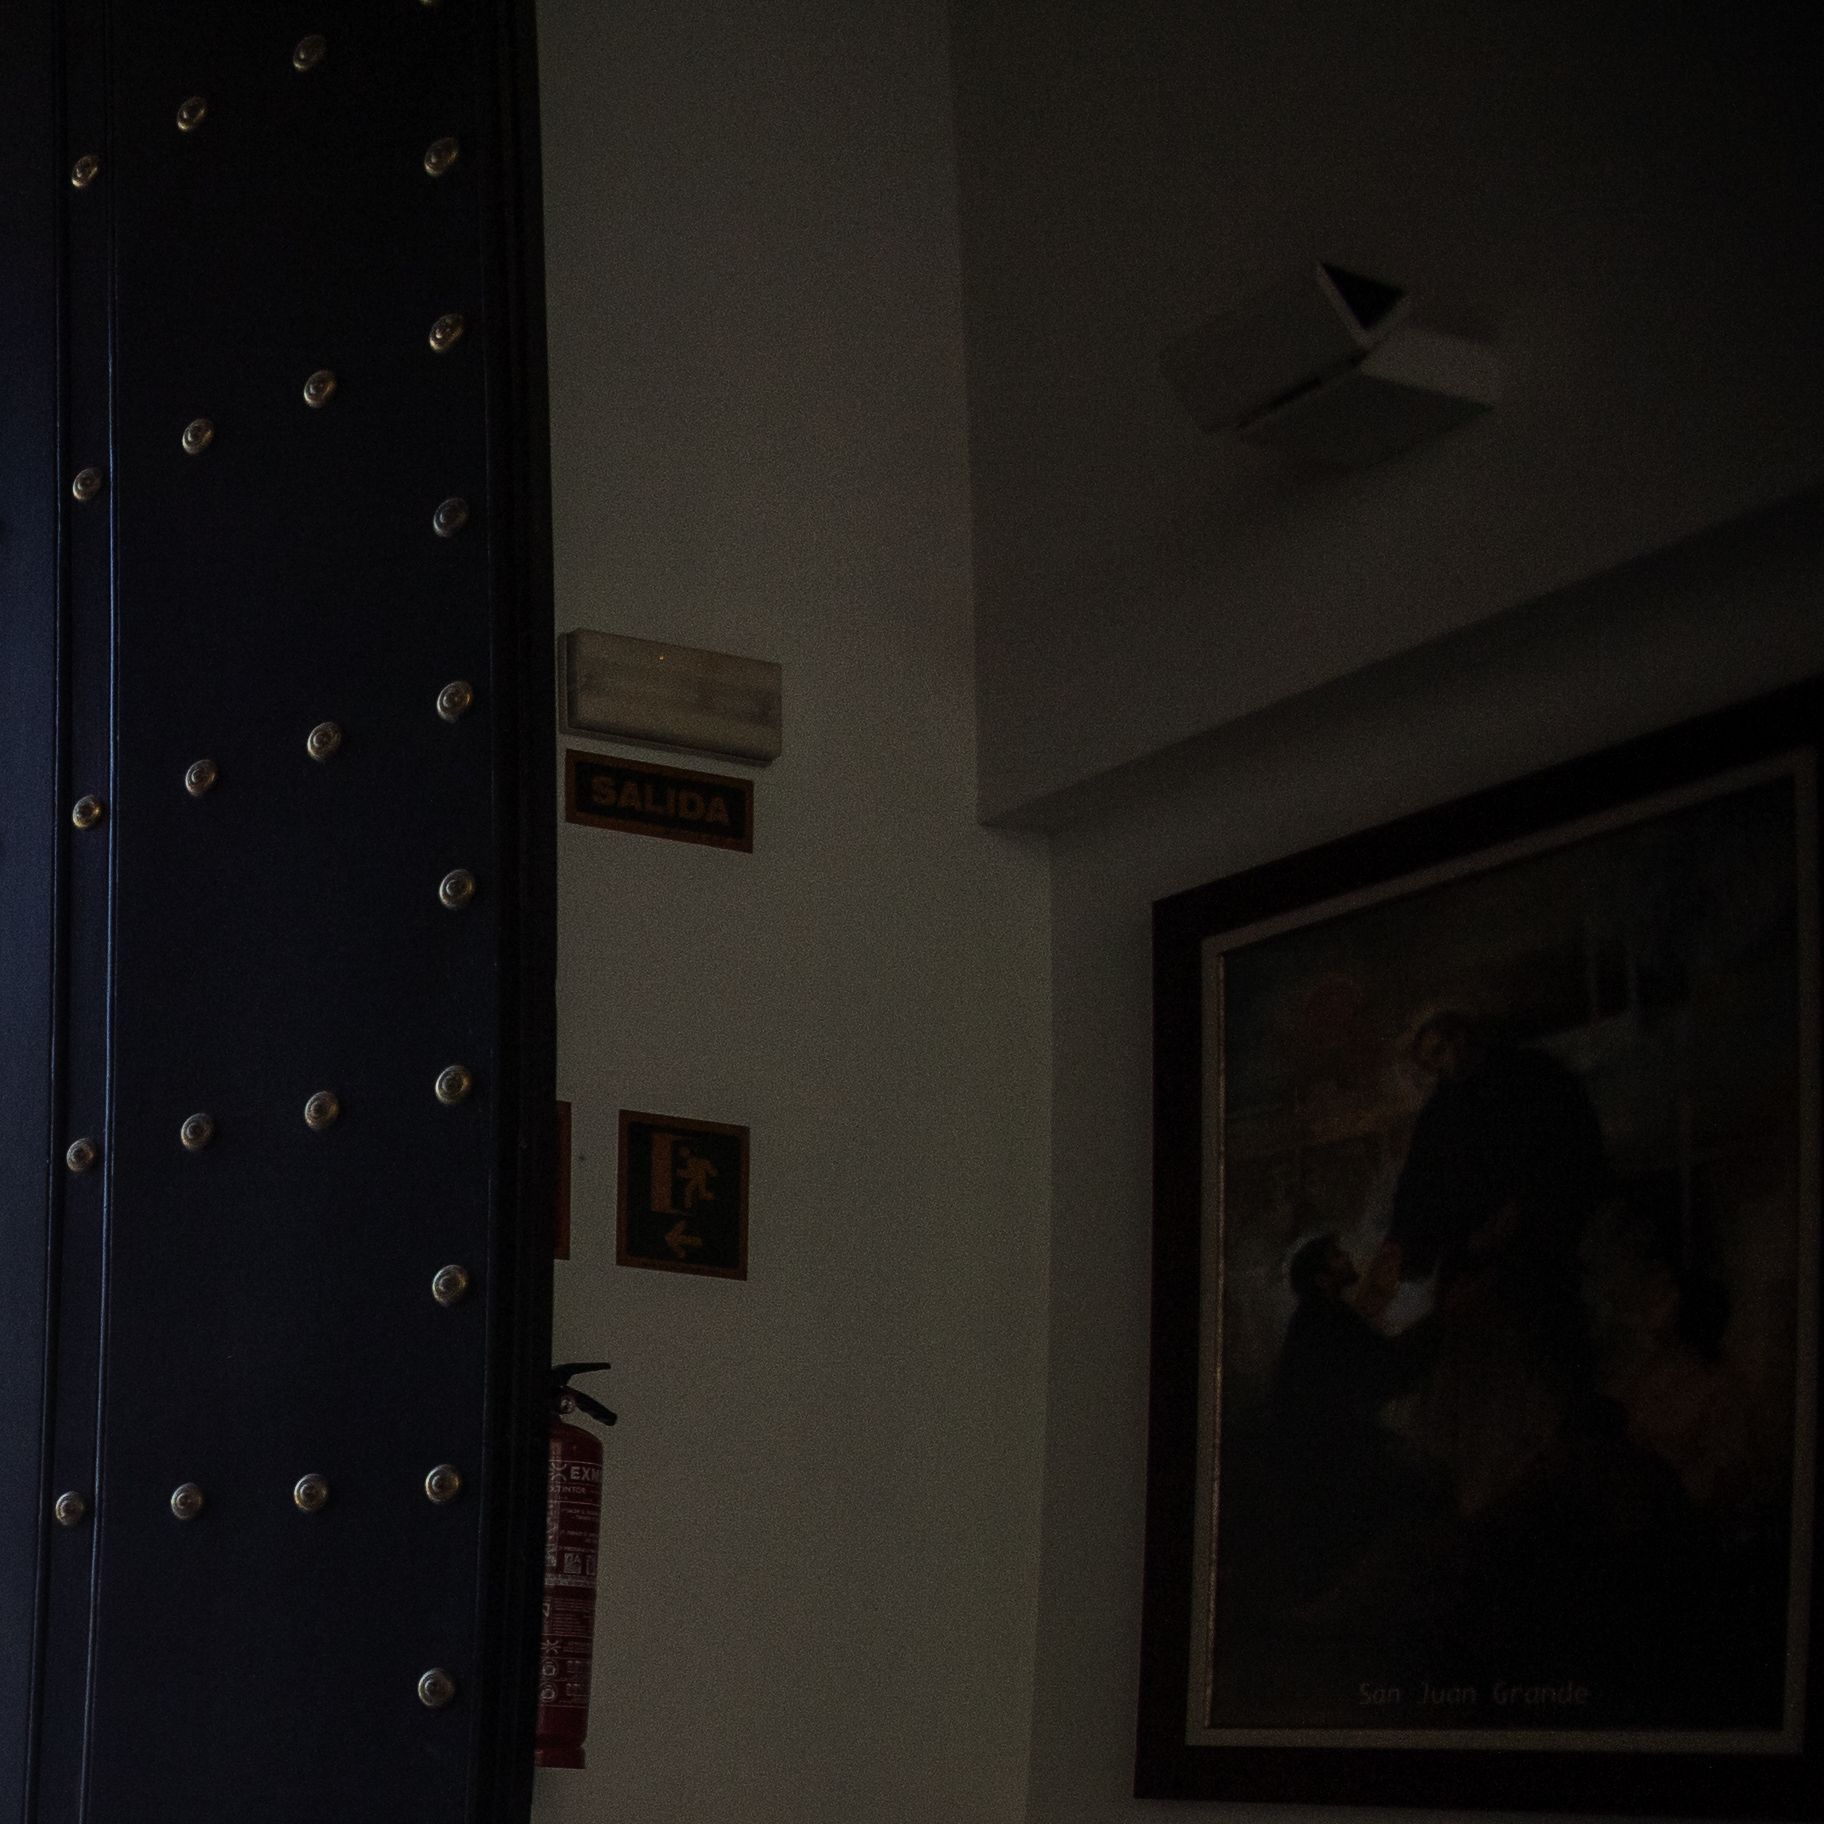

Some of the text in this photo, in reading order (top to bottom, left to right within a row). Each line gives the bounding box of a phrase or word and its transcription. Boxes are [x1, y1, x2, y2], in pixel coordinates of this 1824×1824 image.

[592, 774, 729, 825] SALIDA
[1358, 1680, 1589, 1705] San Juan Grande
